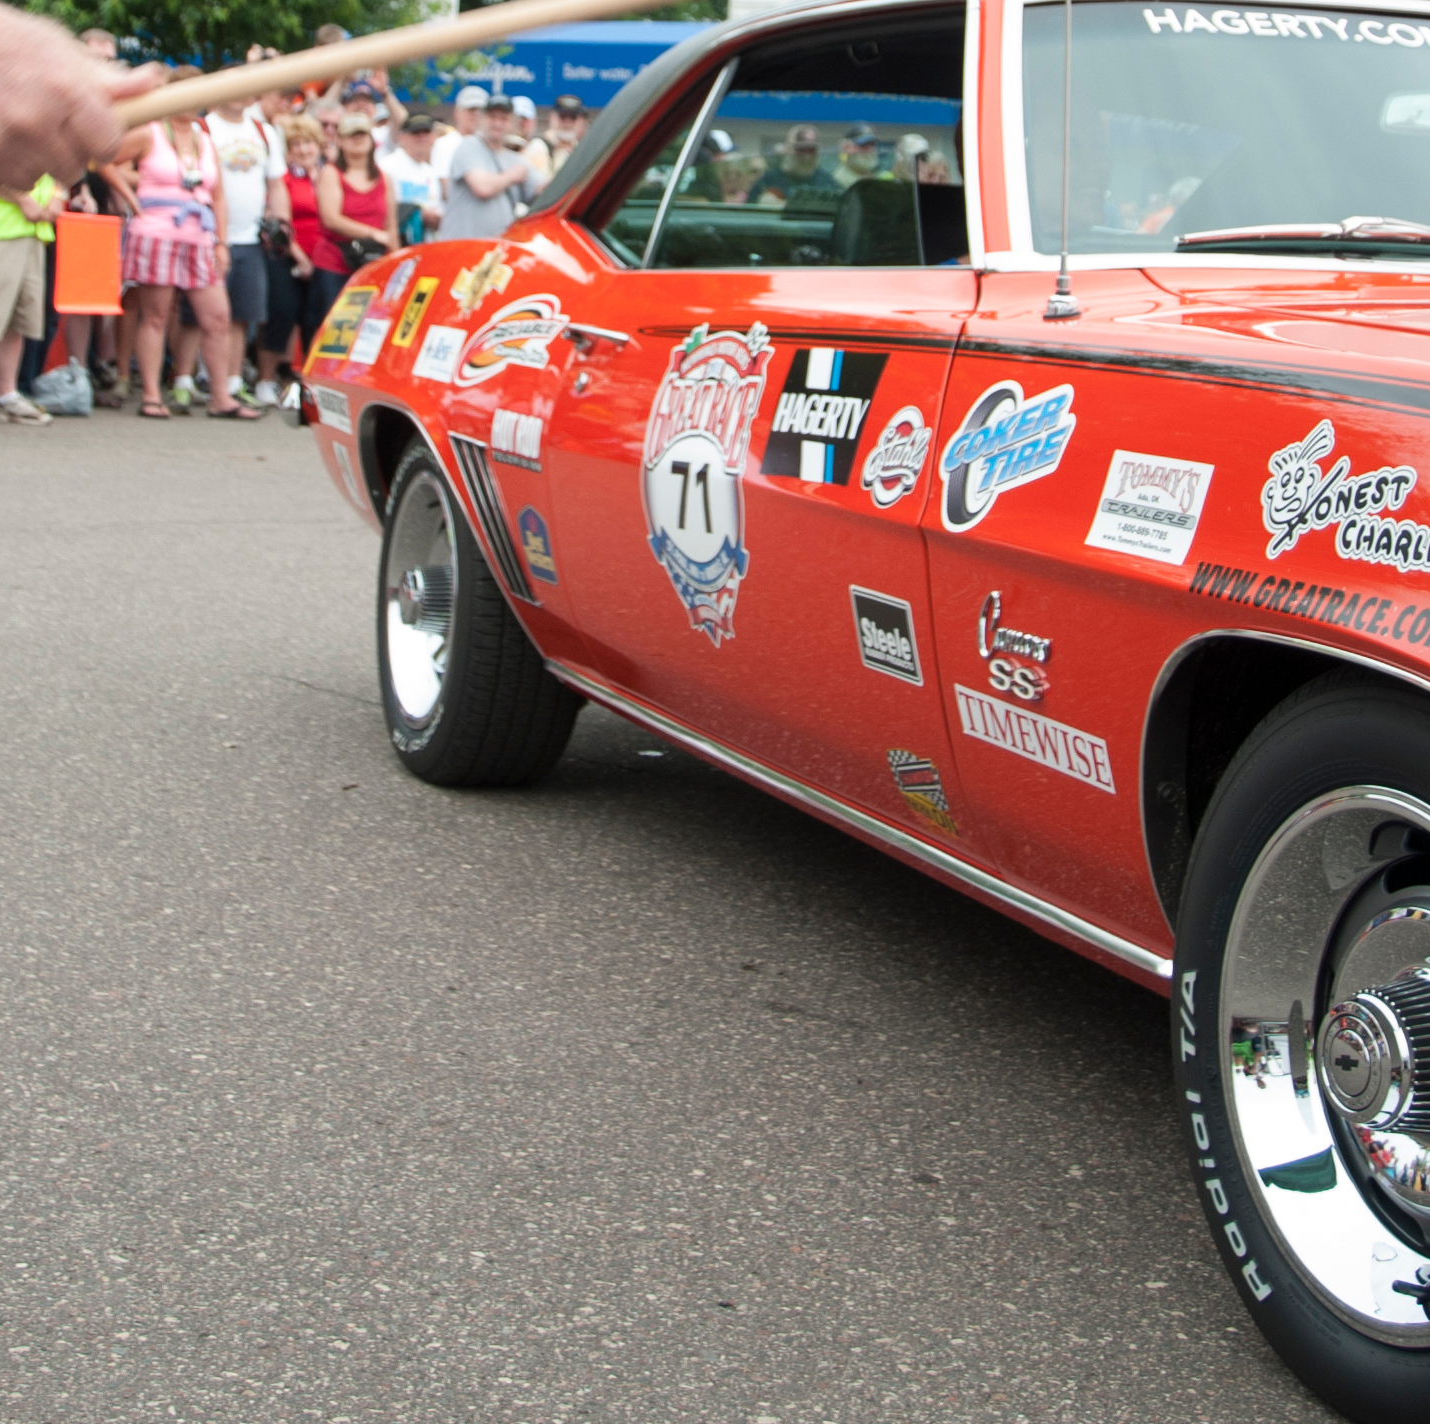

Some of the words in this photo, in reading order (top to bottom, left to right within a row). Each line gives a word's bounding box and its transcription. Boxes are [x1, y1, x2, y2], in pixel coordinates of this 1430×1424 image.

[772, 392, 870, 440] HAGERTY
[944, 393, 1069, 472] COKER
[976, 424, 1071, 494] TIRE
[1114, 461, 1202, 514] TOMMY'S
[671, 460, 714, 534] 71
[1107, 501, 1191, 526] TRAILERS
[860, 617, 912, 661] Steele
[987, 658, 1041, 701] SS
[958, 691, 1112, 788] TIMEWISE
[1187, 1089, 1272, 1302] Radial
